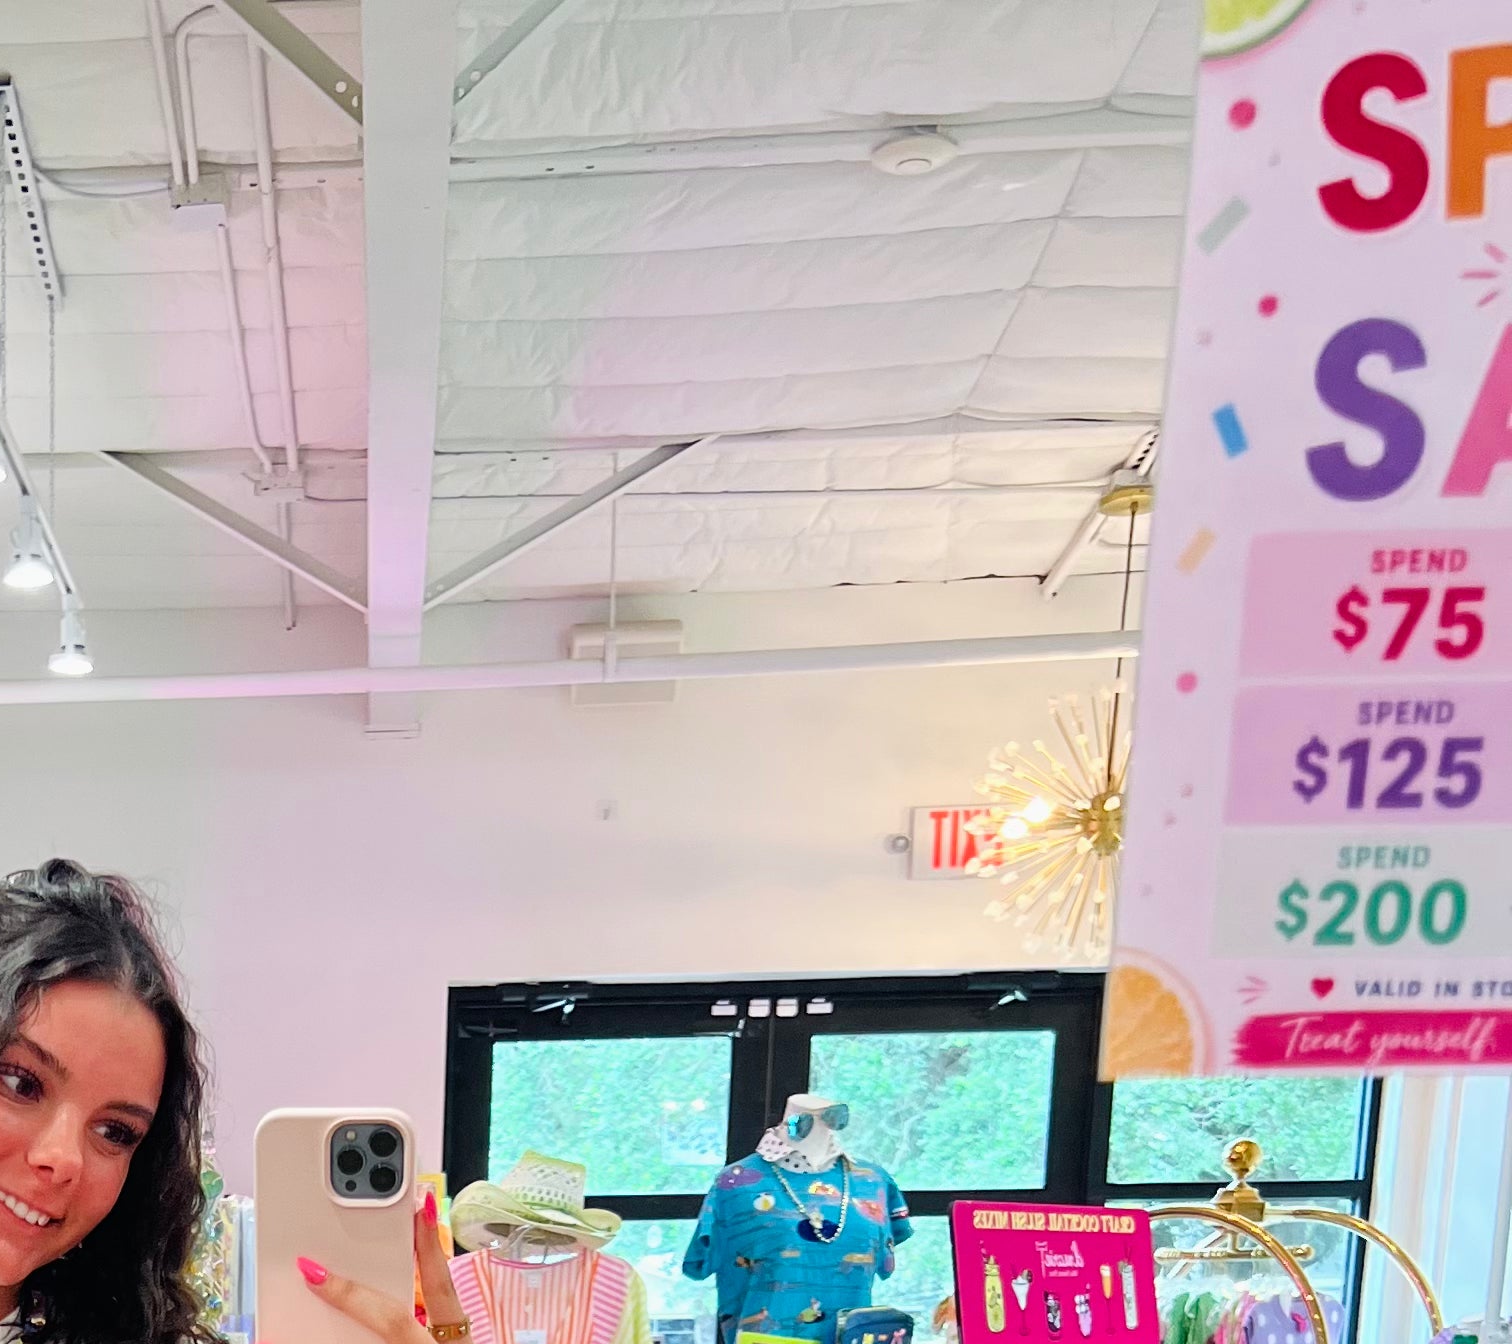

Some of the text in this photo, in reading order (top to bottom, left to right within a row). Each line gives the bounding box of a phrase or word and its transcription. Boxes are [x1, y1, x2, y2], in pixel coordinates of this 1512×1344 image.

[1317, 43, 1512, 234] SP
[1370, 549, 1468, 573] SPEND
[1333, 584, 1486, 661] $75
[1357, 700, 1455, 726] SPEND
[1293, 734, 1485, 809] $125
[1337, 846, 1432, 870] SPEND
[1274, 876, 1468, 946] $200
[1354, 979, 1423, 998] VALID
[1434, 979, 1460, 998] IN
[1281, 1015, 1365, 1059] Treat
